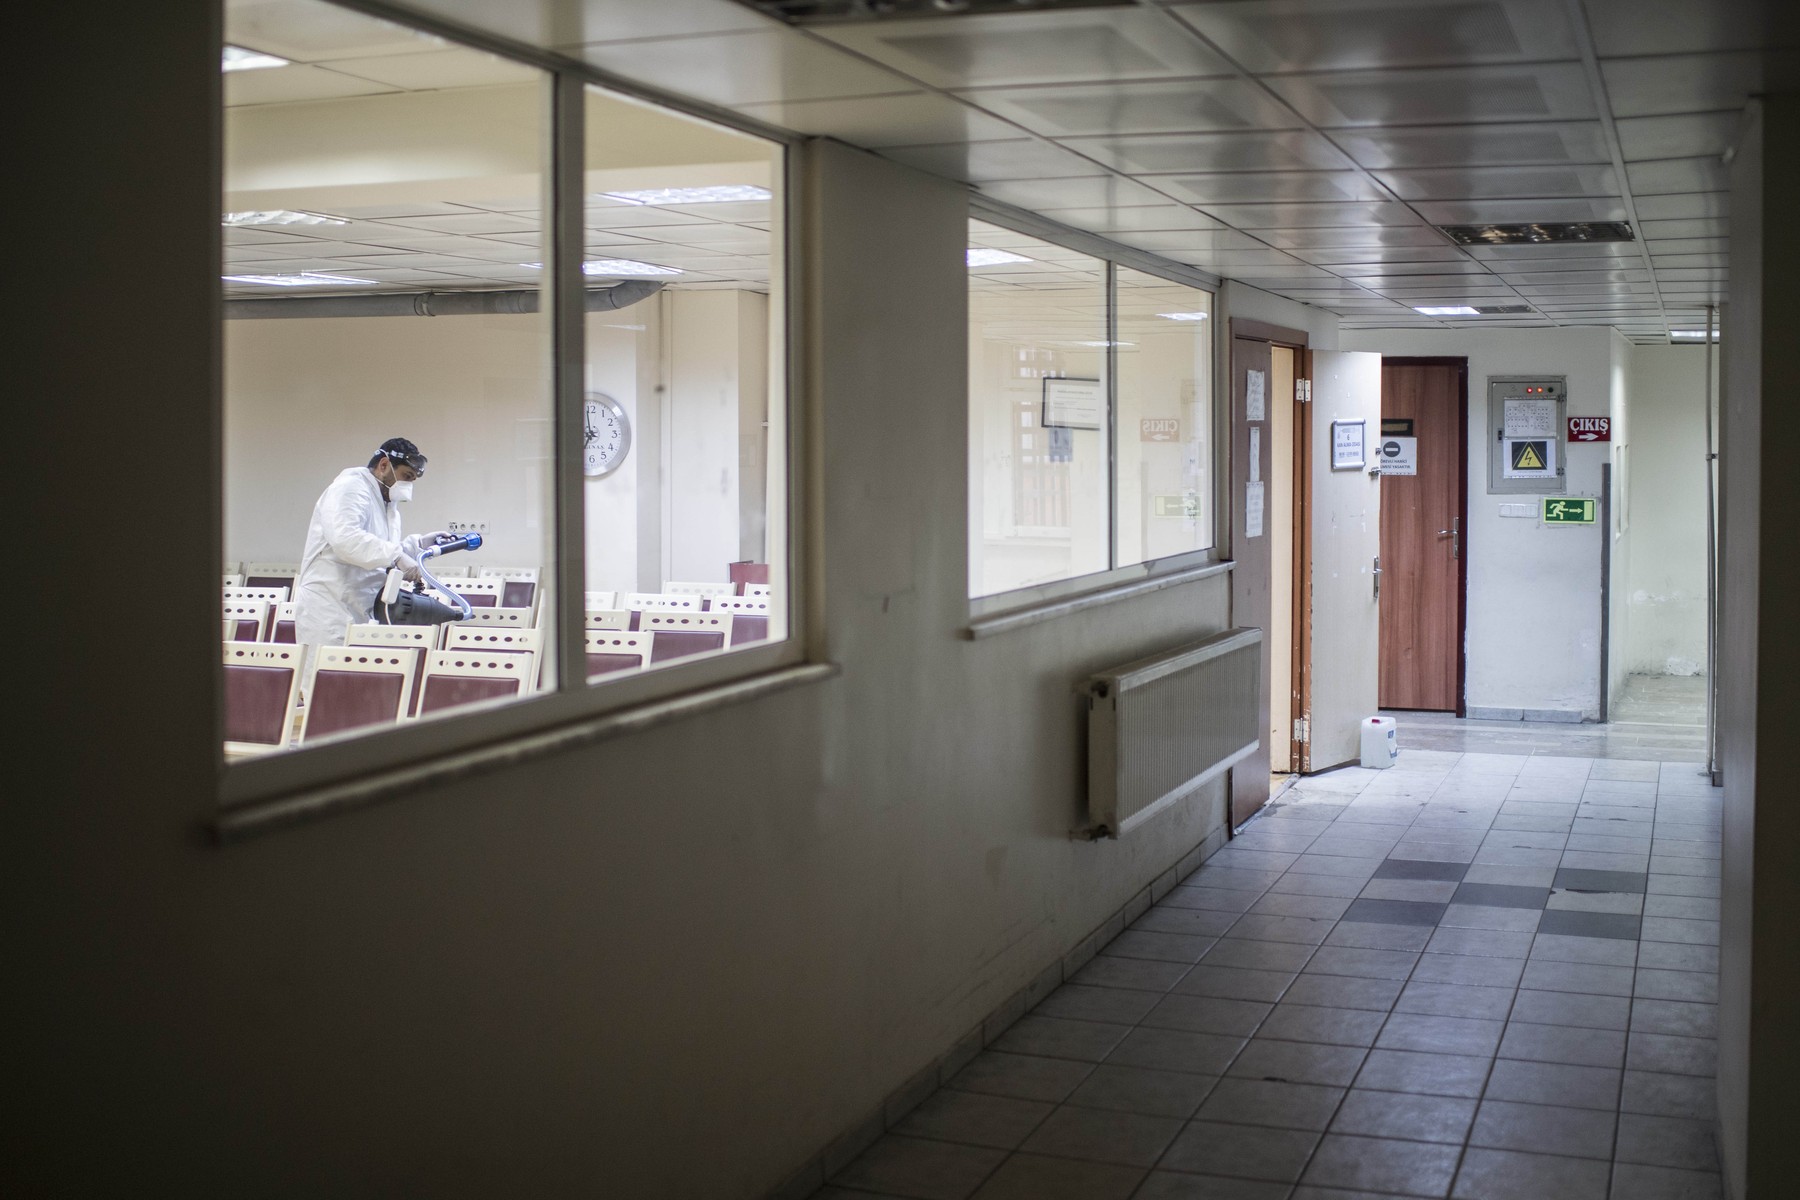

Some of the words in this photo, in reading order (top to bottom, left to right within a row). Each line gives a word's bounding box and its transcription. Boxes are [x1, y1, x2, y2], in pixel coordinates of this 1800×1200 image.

[586, 405, 596, 414] 12
[607, 418, 613, 427] 2
[1570, 418, 1609, 435] ÇIKIŞ
[611, 430, 617, 438] 3
[608, 443, 614, 451] 4
[589, 455, 596, 463] 6
[601, 451, 607, 460] 5
